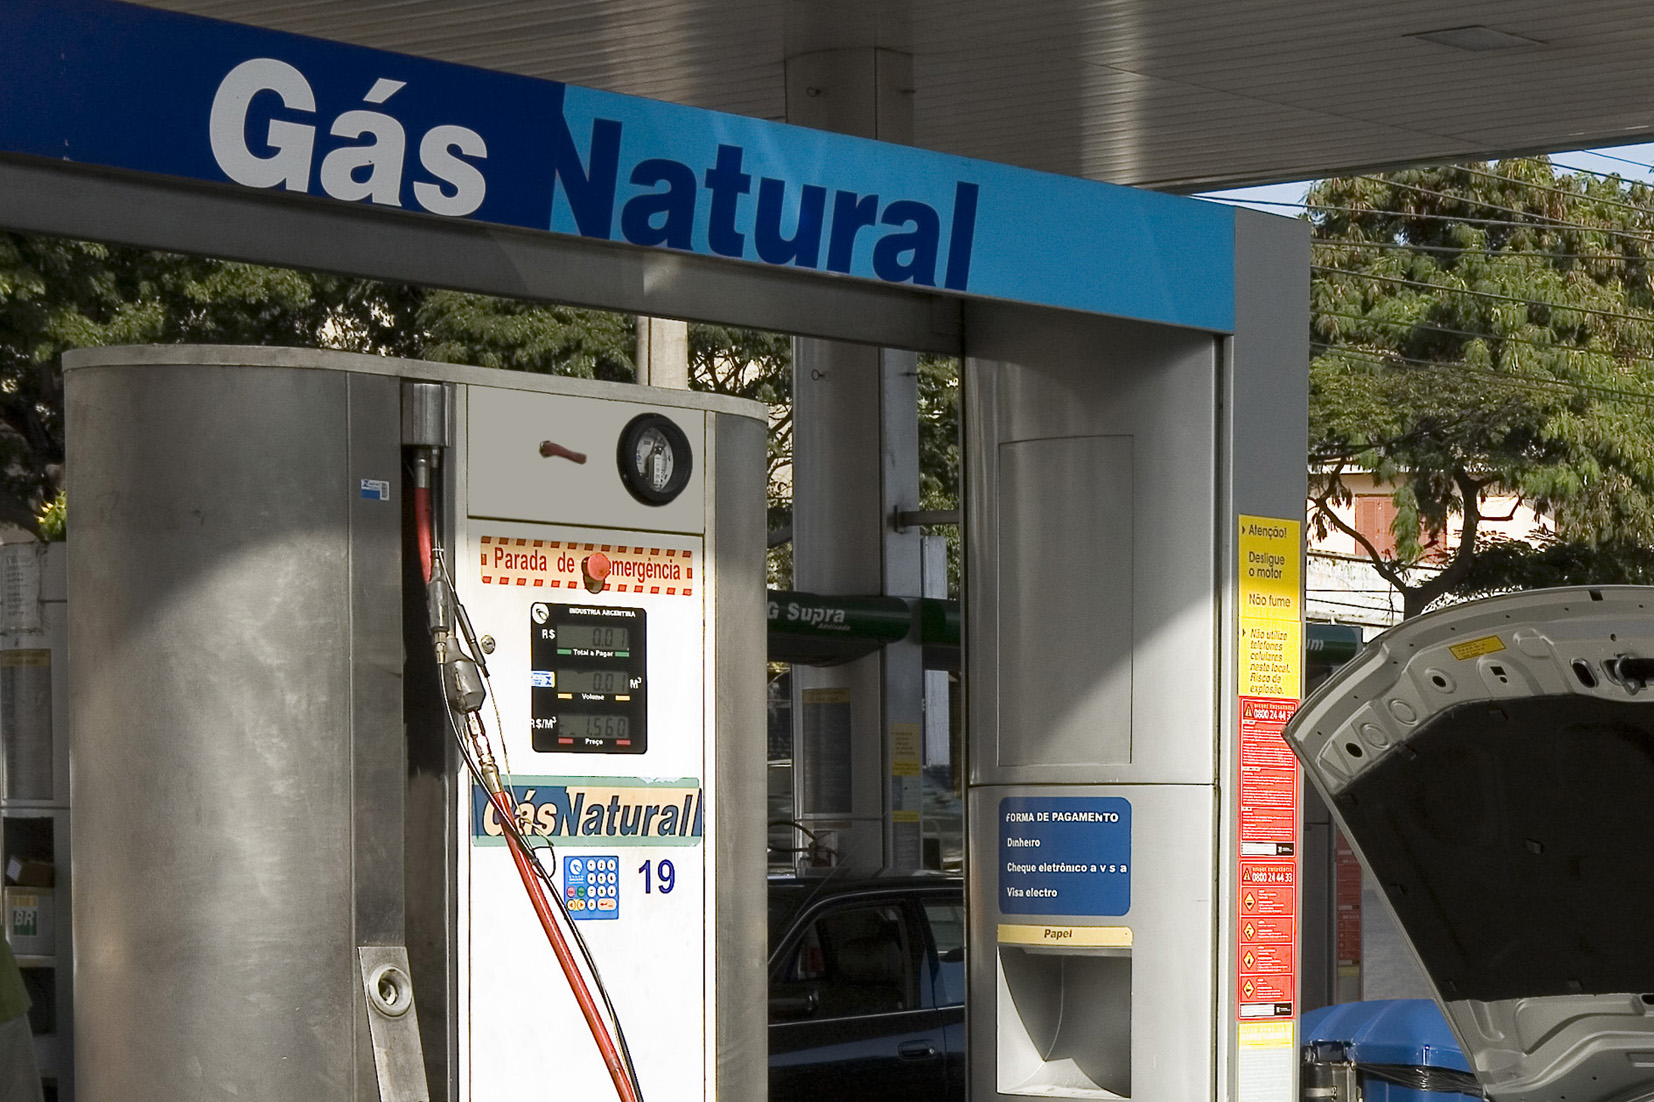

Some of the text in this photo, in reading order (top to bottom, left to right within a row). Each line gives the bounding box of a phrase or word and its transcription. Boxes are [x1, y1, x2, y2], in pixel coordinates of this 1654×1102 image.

[209, 57, 980, 292] Gás Natural
[1249, 524, 1287, 540] Atenção!
[494, 547, 547, 572] Parada
[557, 551, 575, 573] de
[1249, 551, 1285, 567] Desligue
[1249, 567, 1282, 579] o motor
[1249, 593, 1291, 607] Não fume
[786, 602, 845, 625] Supra
[541, 629, 556, 639] R$
[1250, 628, 1265, 639] Não
[1250, 640, 1283, 651] telefones
[573, 648, 588, 656] Total
[1250, 651, 1283, 662] celulares
[1250, 662, 1270, 672] neste
[1250, 672, 1281, 683] Risco de
[1250, 684, 1284, 695] explosão.
[1269, 709, 1277, 720] 24
[1278, 710, 1286, 720] 44
[585, 737, 603, 746] Preço
[483, 790, 693, 836] Gás Natural
[1006, 812, 1119, 822] FORMA DE PAGAMENTO
[1007, 838, 1041, 847] Dinheiro
[1007, 862, 1037, 874] Cheque
[1038, 862, 1087, 873] eletrônico
[638, 858, 676, 894] 19
[1252, 873, 1267, 882] 0800
[1267, 873, 1275, 882] 24
[1276, 873, 1284, 882] 44
[1006, 887, 1058, 897] Visa electro
[14, 910, 34, 926] BR
[1044, 929, 1073, 940] Papel
